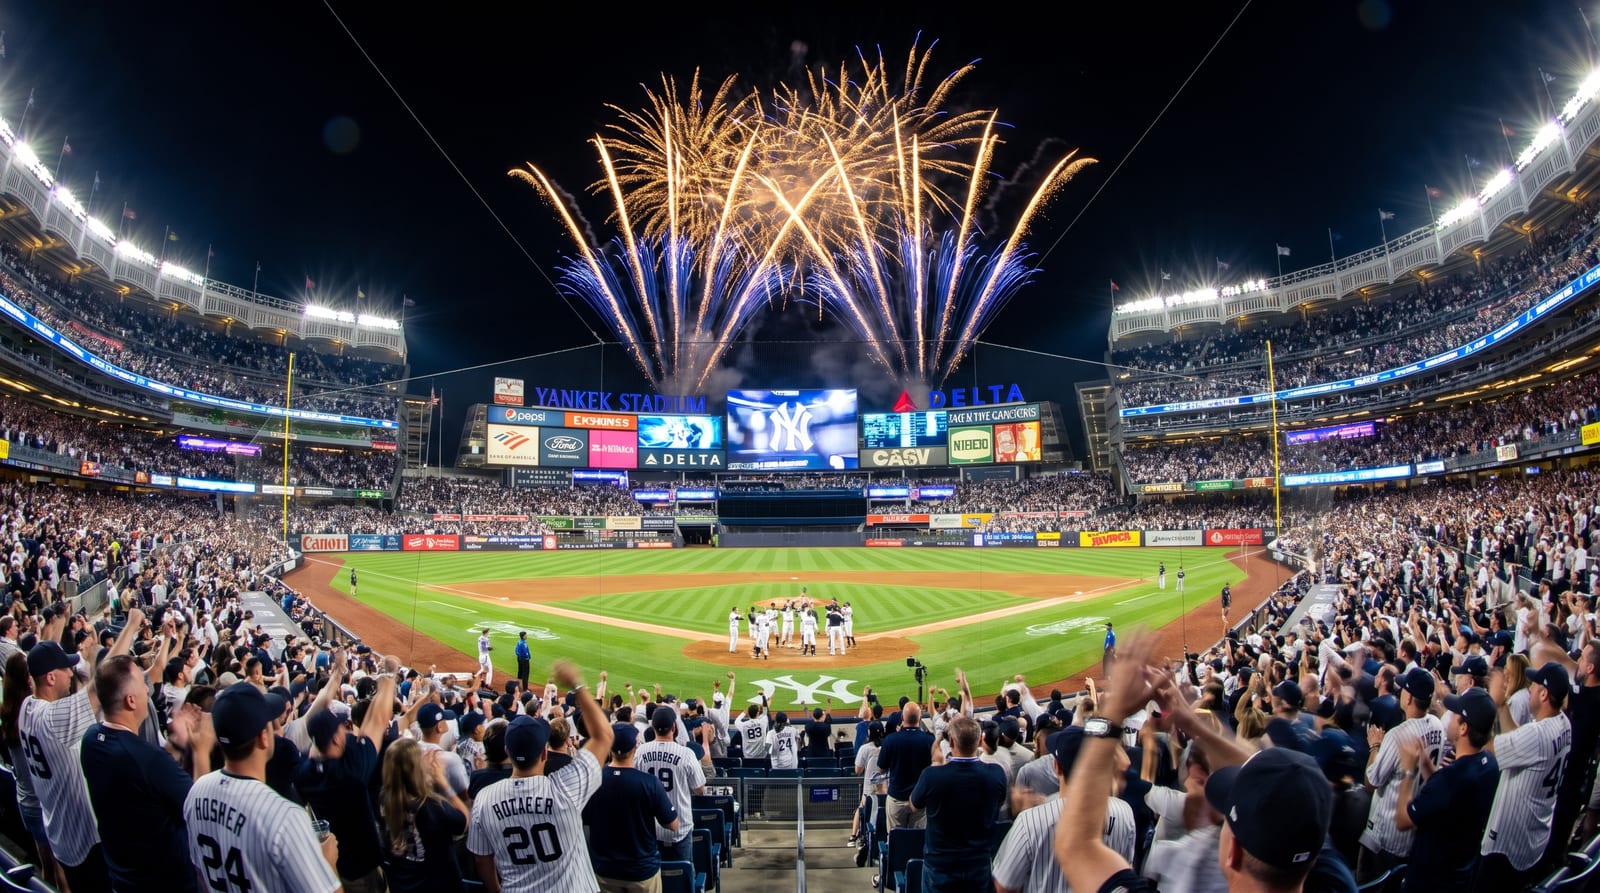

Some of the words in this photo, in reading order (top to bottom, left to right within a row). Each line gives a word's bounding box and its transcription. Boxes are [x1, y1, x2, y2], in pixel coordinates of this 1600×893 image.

[619, 393, 706, 414] STADIUM
[929, 383, 1024, 409] DELTA
[517, 411, 546, 422] pepsi
[663, 453, 721, 465] DELTA
[302, 536, 347, 550] Canon
[747, 727, 762, 739] 83
[778, 738, 792, 752] 24
[195, 797, 247, 837] HOSHER
[502, 822, 563, 865] 20
[196, 833, 252, 893] 24
